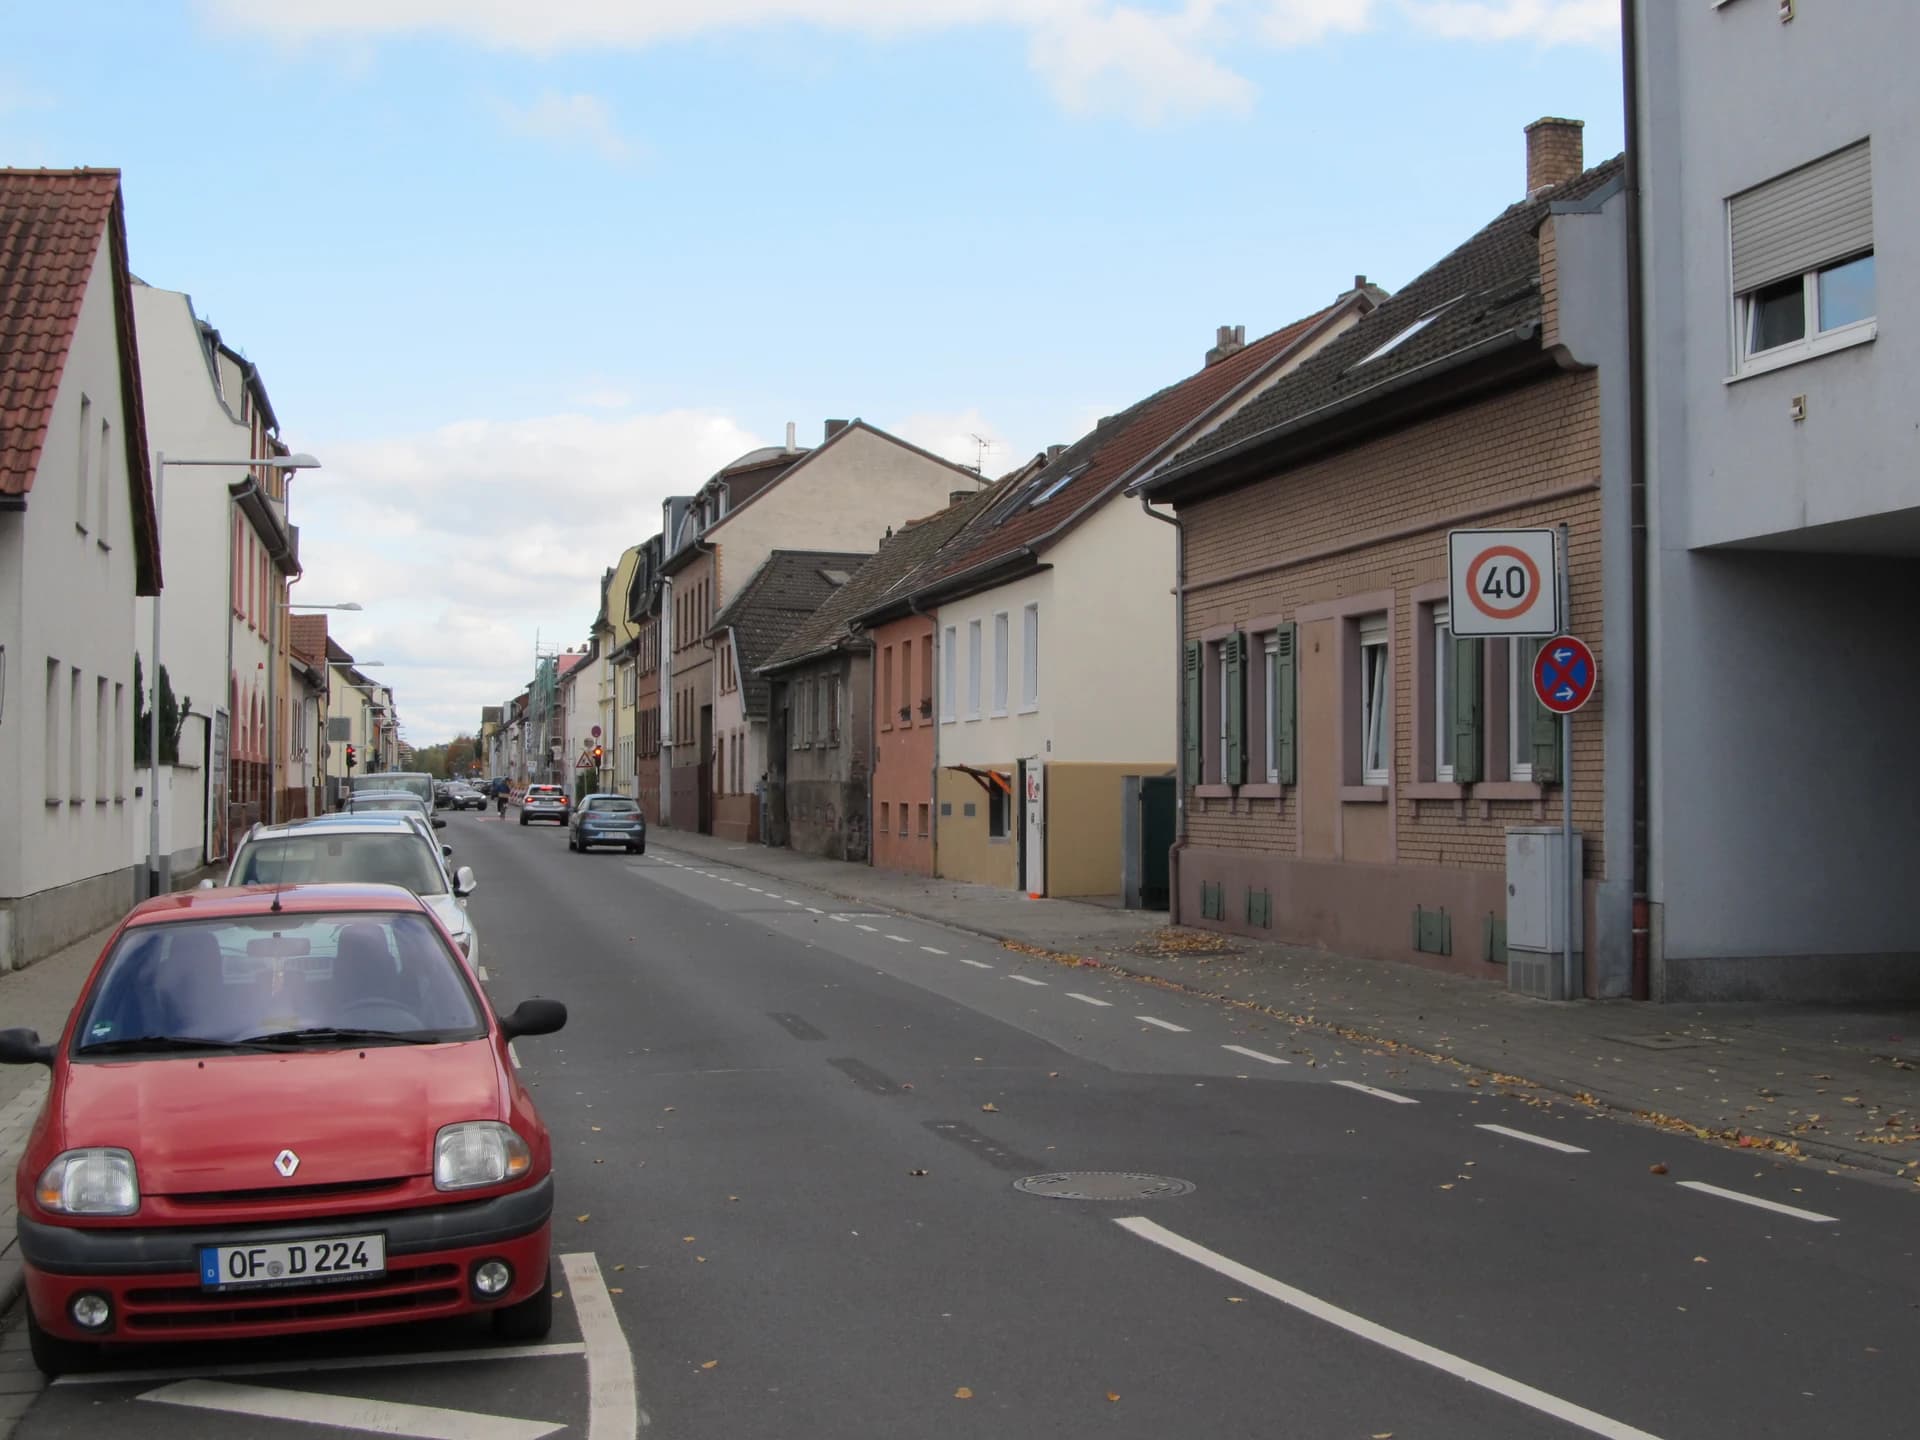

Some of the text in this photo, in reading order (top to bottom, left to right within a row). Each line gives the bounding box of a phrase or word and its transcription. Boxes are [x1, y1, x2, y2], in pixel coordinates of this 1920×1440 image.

[1482, 566, 1525, 598] 40
[229, 1241, 369, 1279] OF D 224
